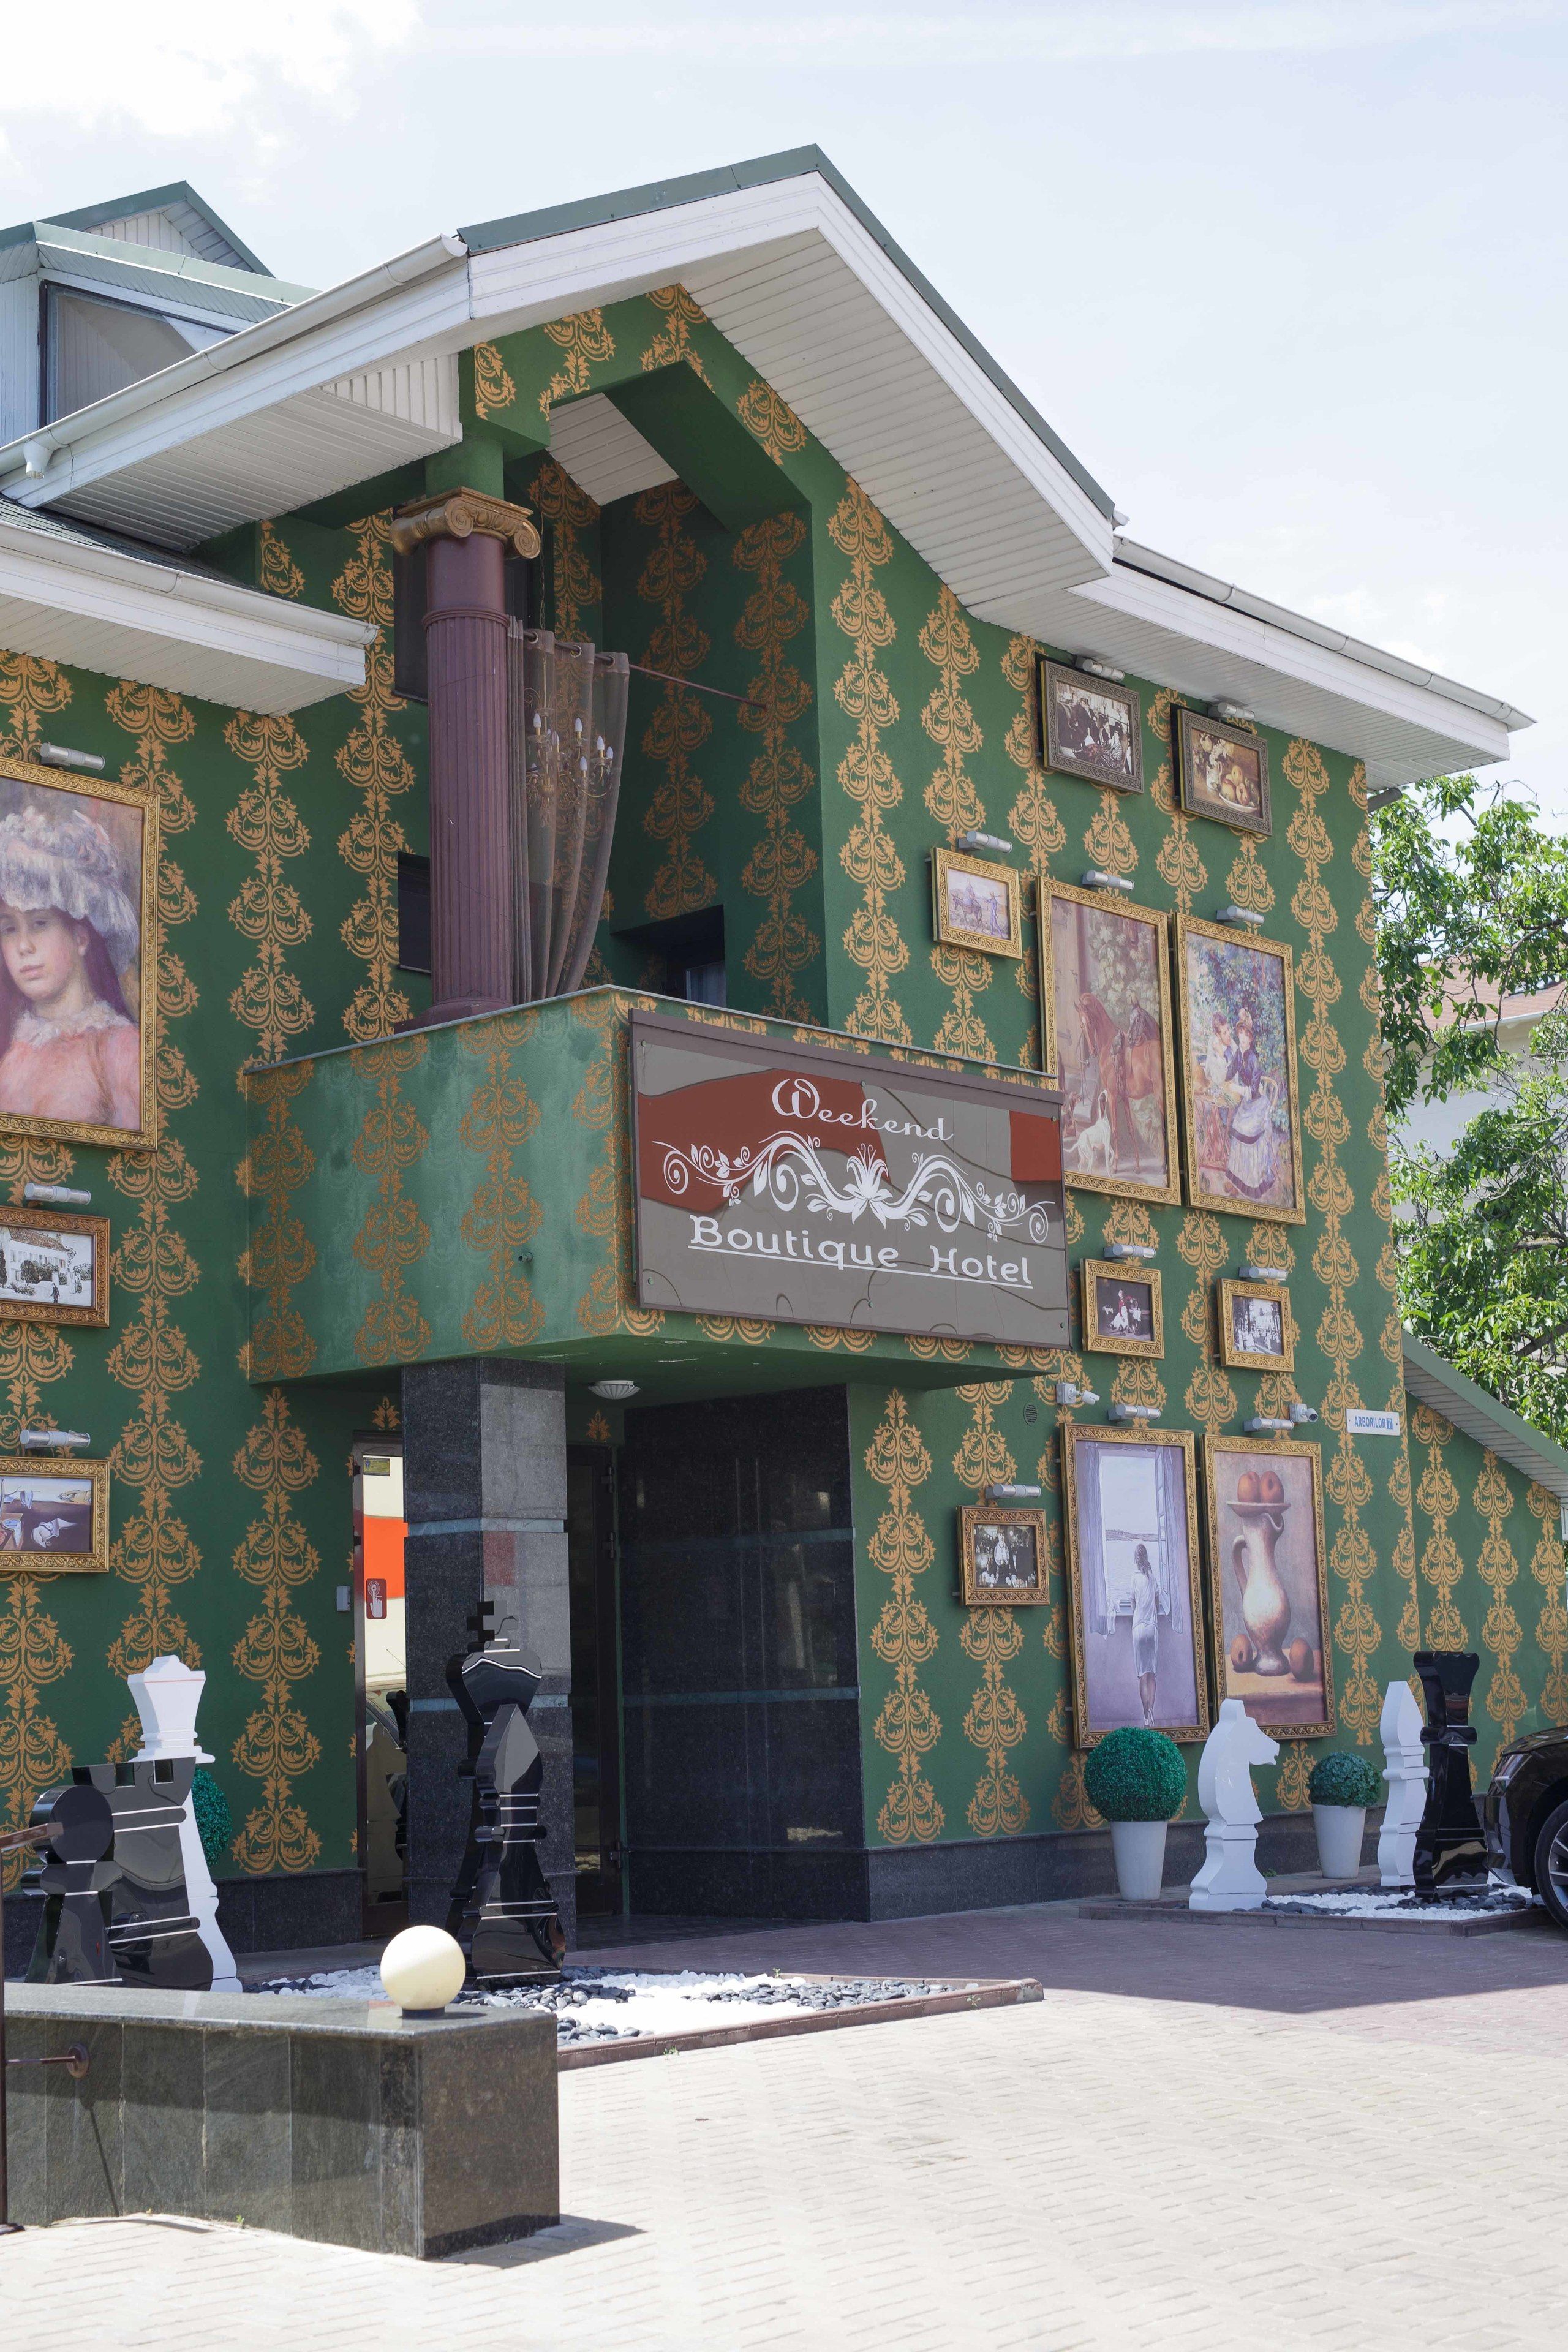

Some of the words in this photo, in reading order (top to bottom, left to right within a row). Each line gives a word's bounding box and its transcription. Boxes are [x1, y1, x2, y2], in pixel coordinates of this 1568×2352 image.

[772, 1078, 954, 1141] Weekend
[689, 1215, 899, 1270] Boutique
[929, 1245, 1033, 1285] Hotel
[1354, 1416, 1386, 1428] ARBORILOR
[1387, 1419, 1392, 1428] 7
